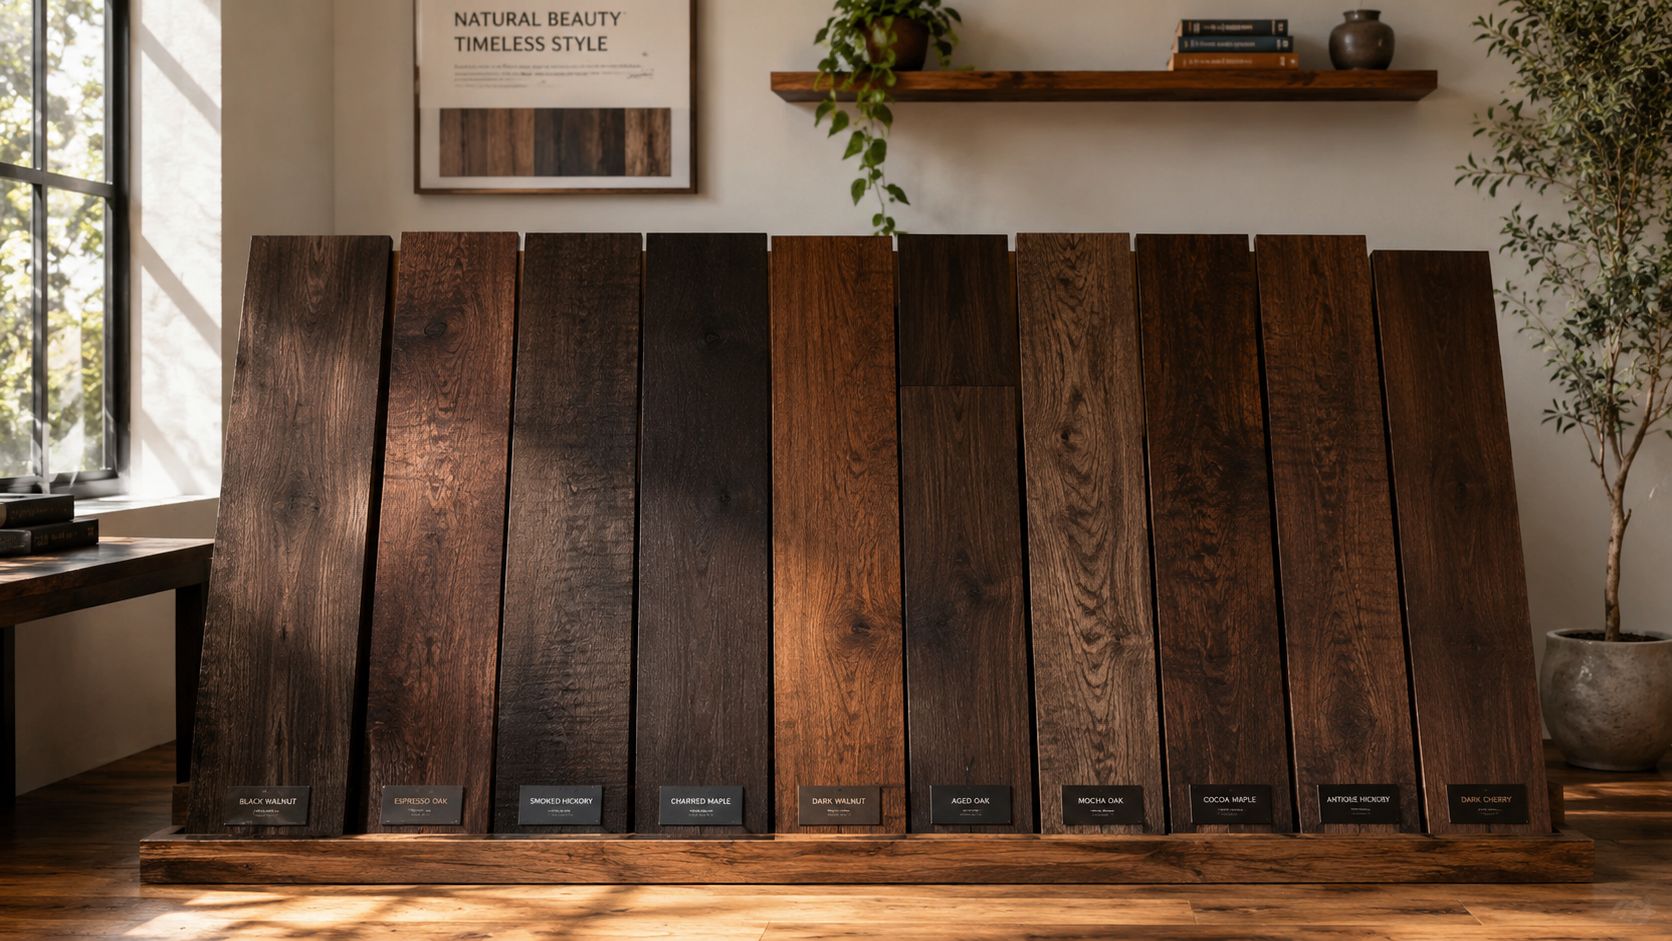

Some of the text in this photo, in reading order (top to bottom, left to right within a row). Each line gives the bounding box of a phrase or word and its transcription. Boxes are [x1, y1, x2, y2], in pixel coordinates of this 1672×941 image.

[454, 11, 622, 27] NATURAL BEAUTY
[454, 35, 608, 52] TIMELESS STYLE
[239, 797, 297, 805] BLACK WALNUT
[394, 797, 448, 805] ESPRESSO OAK
[530, 797, 561, 805] SMOKED
[670, 797, 731, 805] CHARRED MAPLE
[812, 797, 866, 805] DARK WALNUT
[952, 797, 990, 805] AGED OAK
[1203, 796, 1256, 804] COCOA MAPLE
[1461, 796, 1512, 804] DARK CHERRY
